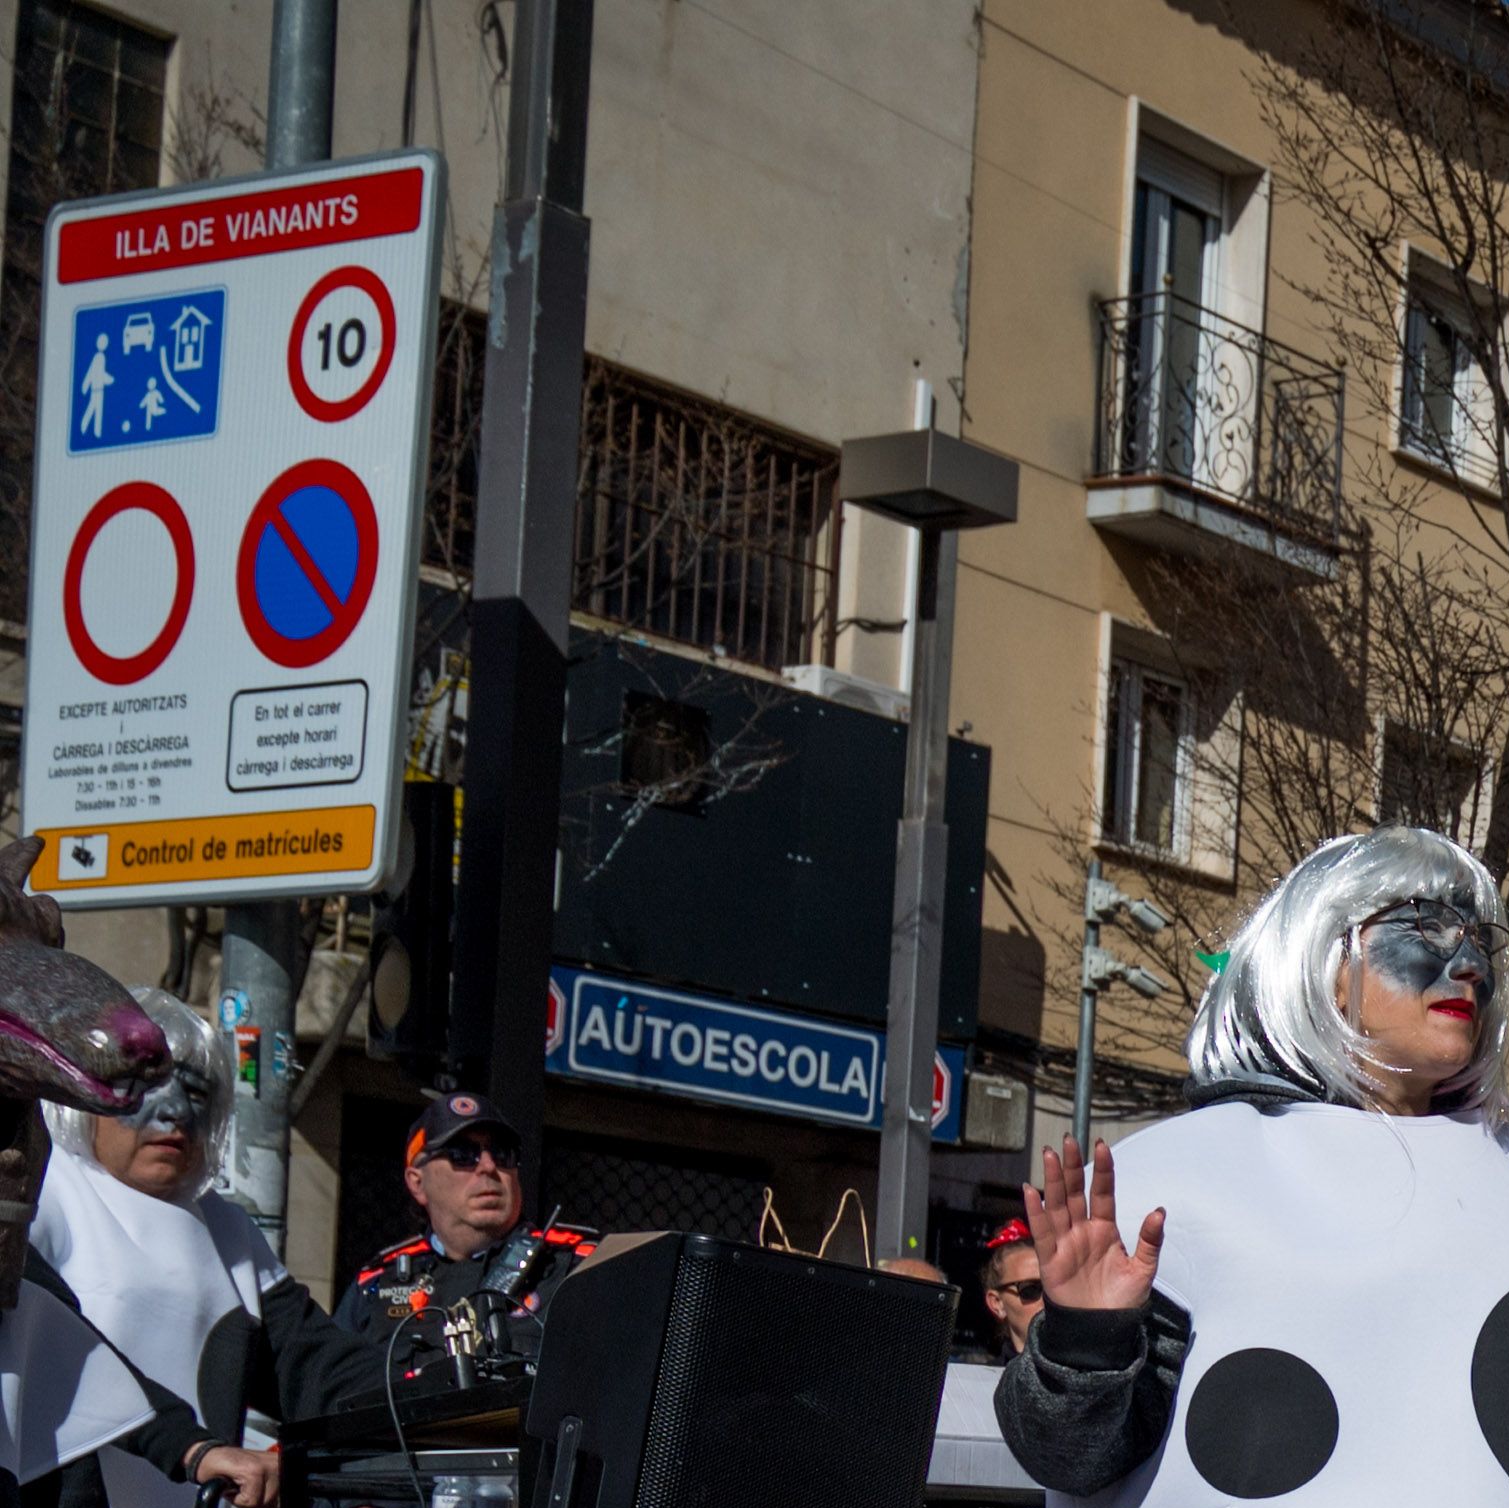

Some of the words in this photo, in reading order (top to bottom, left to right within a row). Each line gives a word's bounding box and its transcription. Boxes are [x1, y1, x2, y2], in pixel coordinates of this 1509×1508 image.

[115, 226, 171, 260] ILLA
[180, 217, 215, 250] DE
[226, 194, 359, 242] VIANANTS
[317, 318, 366, 371] 10
[59, 702, 107, 720] EXCEPTE
[112, 694, 188, 715] AUTORITZATS
[254, 705, 269, 721] En
[274, 704, 289, 719] tot
[293, 702, 304, 717] el
[307, 702, 341, 716] carrer
[53, 742, 104, 761] CÀRREGA
[115, 734, 189, 755] DESCÀRREGA
[256, 730, 300, 748] excepte
[304, 726, 337, 743] horari
[97, 763, 108, 774] de
[236, 758, 278, 776] càrrega
[282, 757, 287, 771] i
[290, 753, 354, 769] descàrrega
[121, 838, 195, 867] Control
[202, 833, 227, 861] de
[235, 827, 344, 859] matrícules
[578, 1004, 869, 1098] AUTOESCOLA
